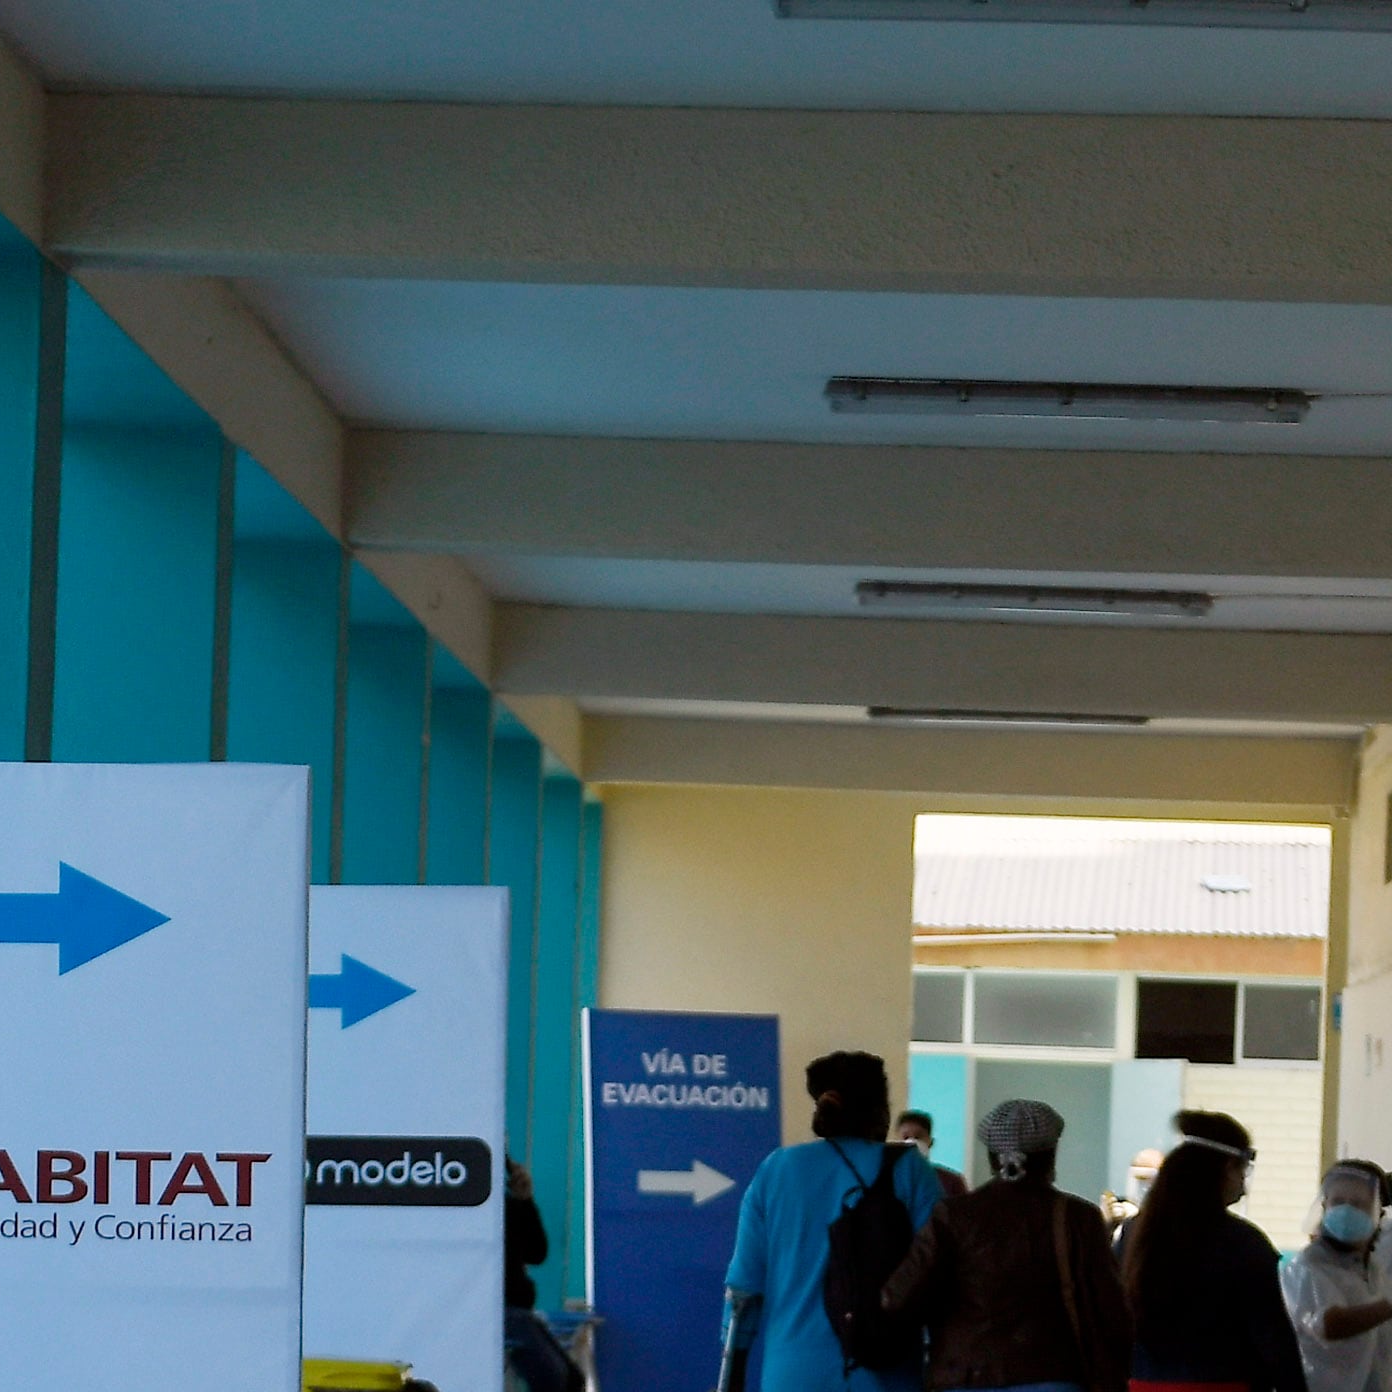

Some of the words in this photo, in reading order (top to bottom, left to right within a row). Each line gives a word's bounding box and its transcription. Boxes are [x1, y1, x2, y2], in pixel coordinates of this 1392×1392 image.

[640, 1047, 686, 1076] VÍA
[693, 1053, 728, 1077] DE
[601, 1080, 770, 1110] EVACUACIÓN
[315, 1151, 467, 1186] modelo
[69, 1219, 86, 1246] y
[94, 1213, 253, 1242] Confianza
